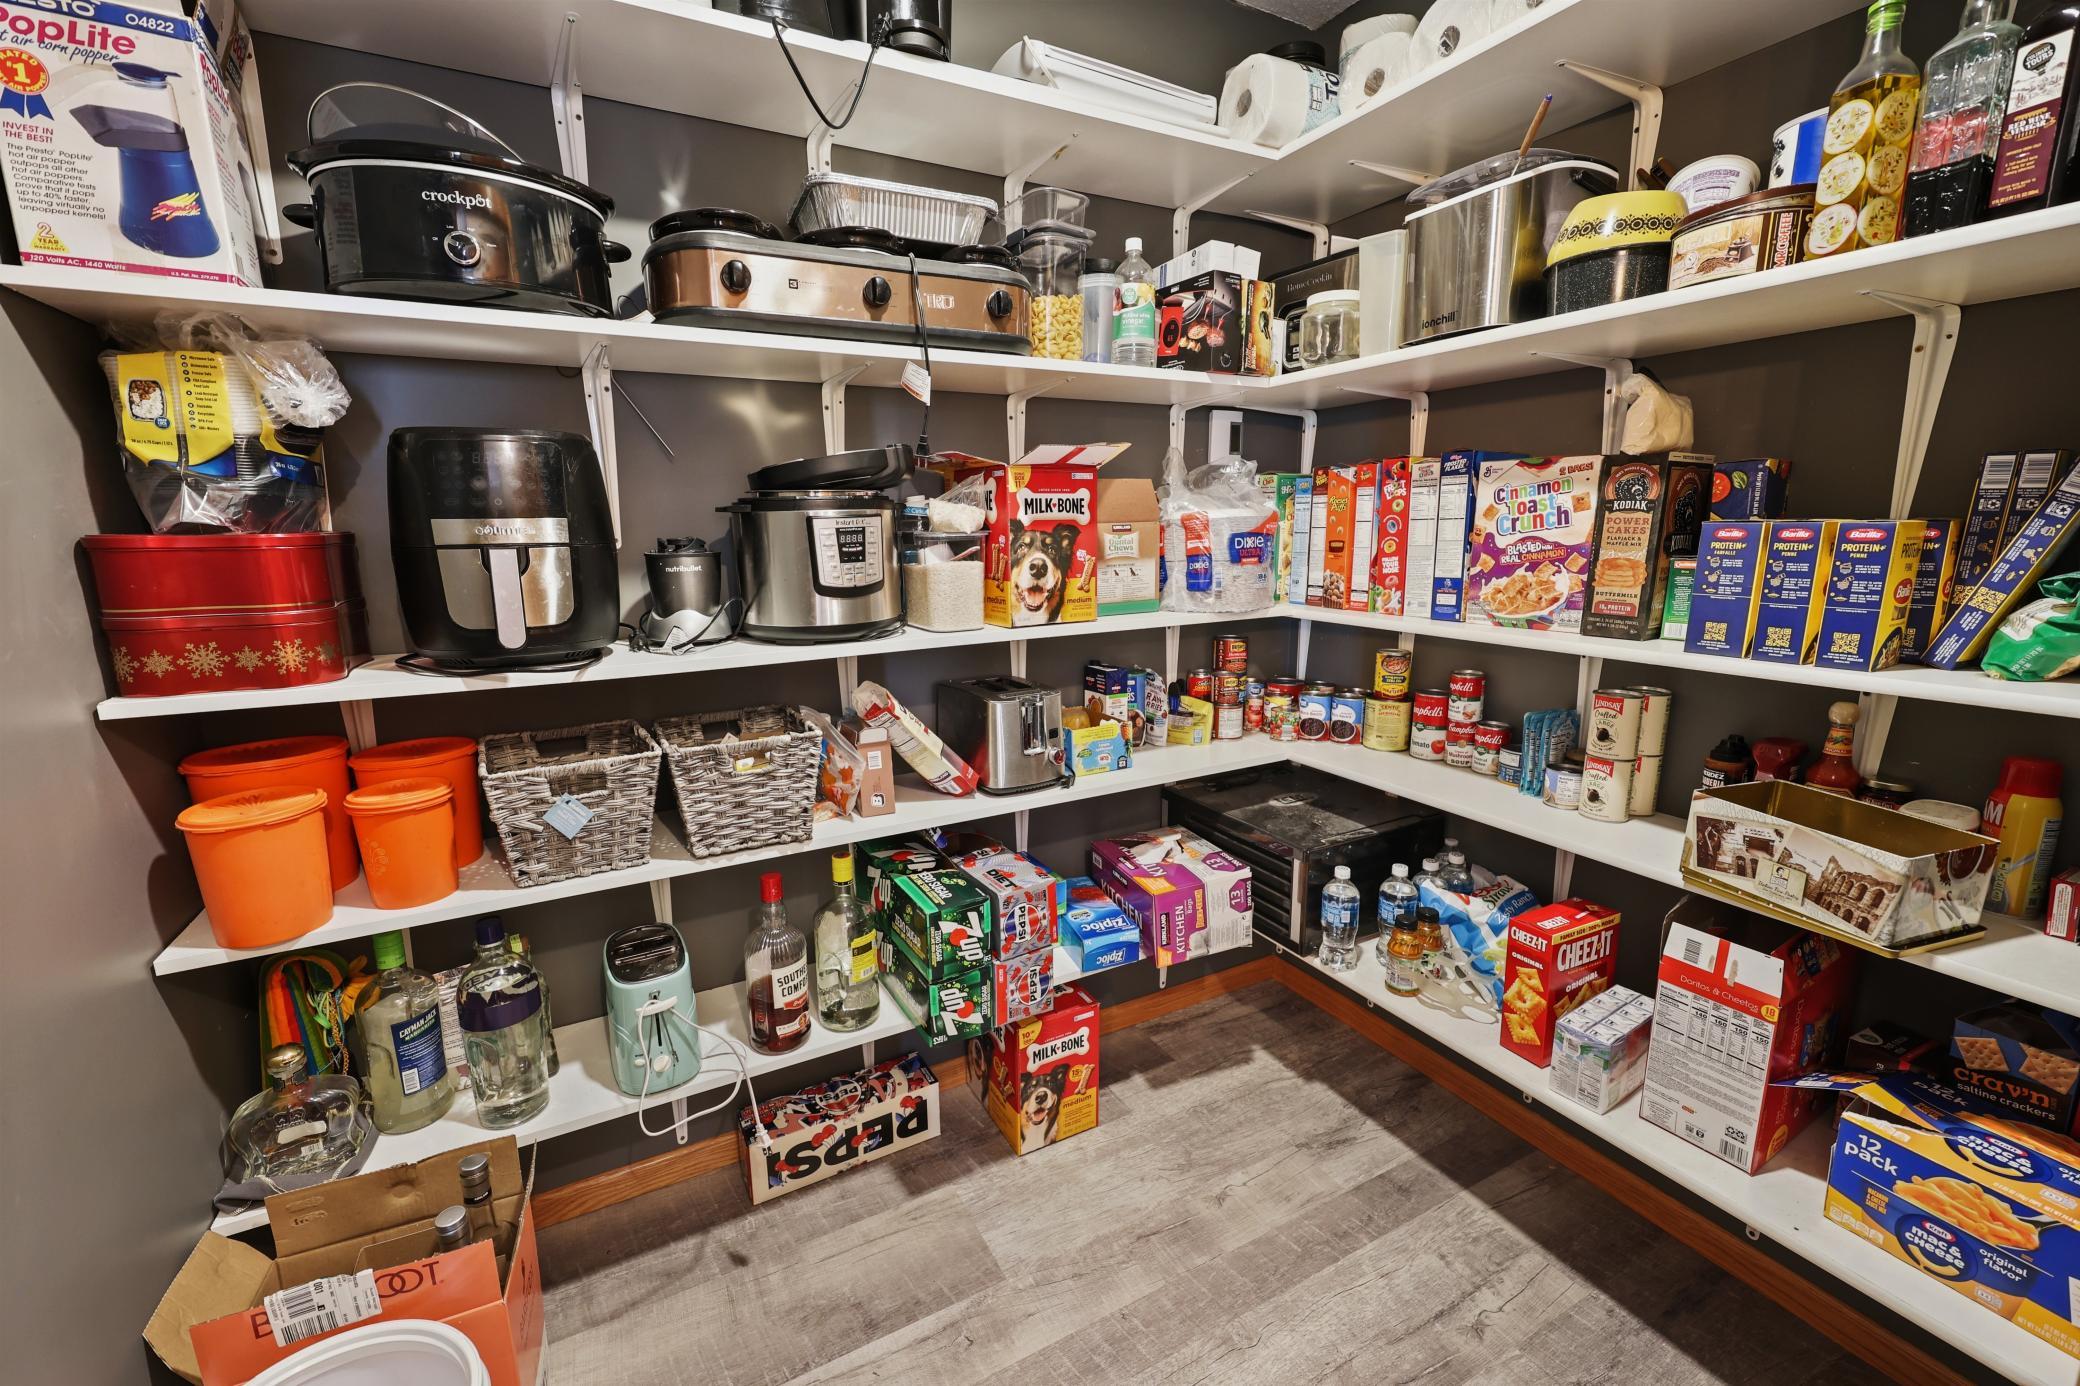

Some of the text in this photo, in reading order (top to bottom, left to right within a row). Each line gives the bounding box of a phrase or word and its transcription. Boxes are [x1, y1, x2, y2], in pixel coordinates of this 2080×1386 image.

[11, 35, 34, 46] air
[38, 41, 68, 54] corn
[69, 46, 120, 65] popper
[2025, 49, 2054, 69] TOURS
[2, 121, 54, 135] INVEST IN
[4, 129, 53, 143] THE BEST!
[7, 142, 23, 151] The
[8, 150, 76, 166] hot air popper
[9, 158, 88, 175] outpops all other
[11, 165, 27, 174] hot
[29, 168, 41, 176] air
[13, 173, 97, 191] Comparative tests
[14, 181, 95, 198] prove that it pops
[16, 189, 29, 197] up
[32, 189, 41, 197] to
[421, 190, 493, 210] crockpot
[18, 195, 105, 213] leaving virtually no
[19, 203, 106, 220] unpopped kernels!
[37, 222, 54, 238] 2
[46, 256, 65, 264] Volts
[85, 259, 103, 268] 1440
[104, 262, 126, 271] Watts
[1421, 311, 1456, 330] ionchill
[1495, 477, 1573, 503] Cinnamon
[1024, 497, 1085, 515] MILK BONE
[1508, 493, 1557, 517] Toast
[1612, 500, 1648, 511] KODIAK
[1498, 504, 1570, 534] Crunch
[1606, 516, 1650, 526] POWER
[1606, 526, 1647, 535] CAKES
[1717, 530, 1745, 538] Barilla
[1849, 530, 1884, 539] Barilla
[1108, 538, 1134, 546] Dental
[1108, 544, 1134, 552] Chews
[1507, 541, 1542, 555] BLASTED
[1501, 548, 1565, 564] REAL CINNAMON
[1595, 591, 1638, 599] BUTTERMILK
[1595, 698, 1622, 712] LINDSAY
[1594, 709, 1619, 720] Crafted
[1586, 760, 1612, 774] LINDSAY
[1586, 770, 1608, 781] Crafted
[985, 868, 1018, 888] DIET
[1100, 878, 1143, 931] KITCHEN
[1230, 889, 1241, 905] 13
[1494, 890, 1535, 925] Zesty Ranch
[1018, 905, 1027, 941] PEPSI
[1081, 915, 1131, 933] Ziploc
[1160, 914, 1168, 945] KIRKLAND
[1175, 905, 1186, 954] KITCHEN
[1096, 948, 1127, 966] Ziploc
[1511, 951, 1544, 970] ORIGINAL
[1029, 967, 1038, 1002] PEPSI
[1565, 971, 1599, 993] ORIGINAL
[1680, 975, 1759, 1012] Doritos & Cheetos
[399, 1018, 425, 1039] CAYMAN
[1032, 1034, 1085, 1064] MILK BONE
[818, 1085, 859, 1103] PEPSI
[1953, 1066, 2050, 1110] crav'n
[1062, 1094, 1092, 1109] medium
[1957, 1082, 2056, 1121] saltine crackers
[766, 1099, 929, 1190] PEPSI
[1857, 1134, 1882, 1154] 12
[1967, 1135, 2015, 1160] mac
[1844, 1141, 1899, 1177] pack
[1927, 1223, 1951, 1241] Kraft
[1910, 1225, 1963, 1259] mac &
[1978, 1247, 2028, 1279] original
[1982, 1257, 2023, 1283] flavor
